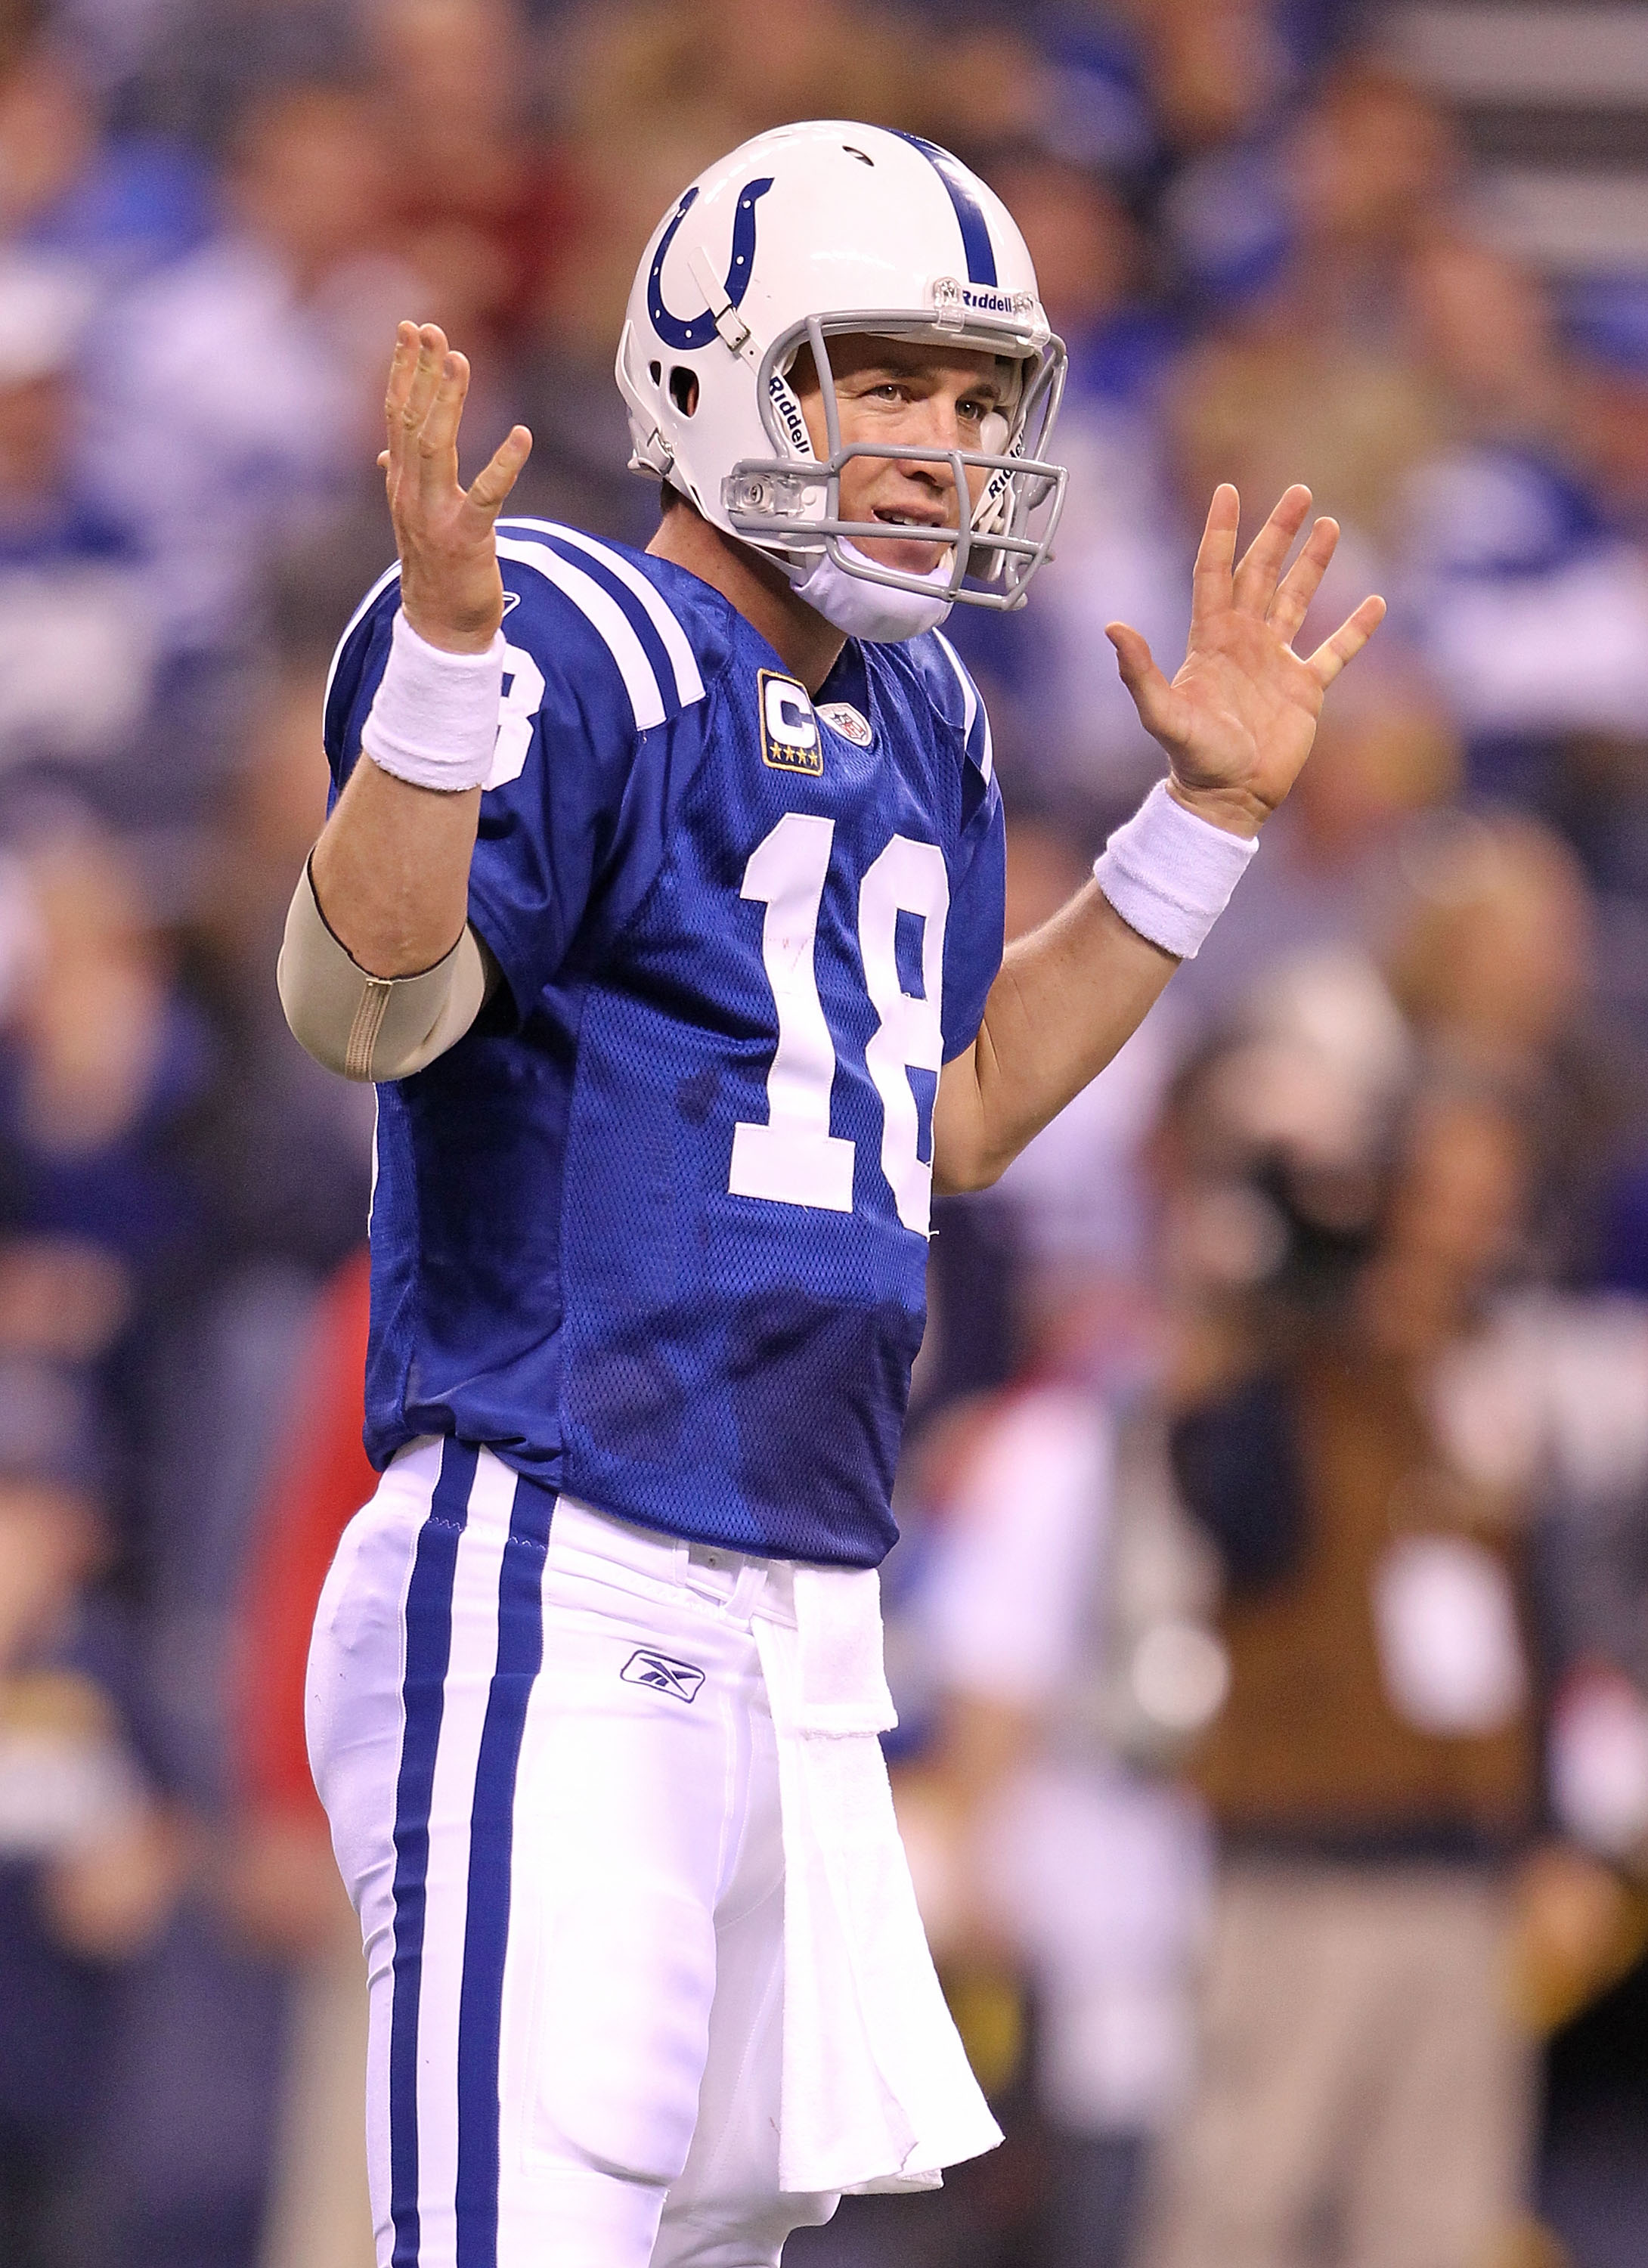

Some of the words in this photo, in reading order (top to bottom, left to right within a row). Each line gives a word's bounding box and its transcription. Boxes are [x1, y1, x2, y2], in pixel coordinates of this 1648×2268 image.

[962, 290, 1011, 312] Riddell
[769, 376, 810, 454] Riddell
[765, 680, 816, 748] C
[730, 812, 949, 1241] 18
